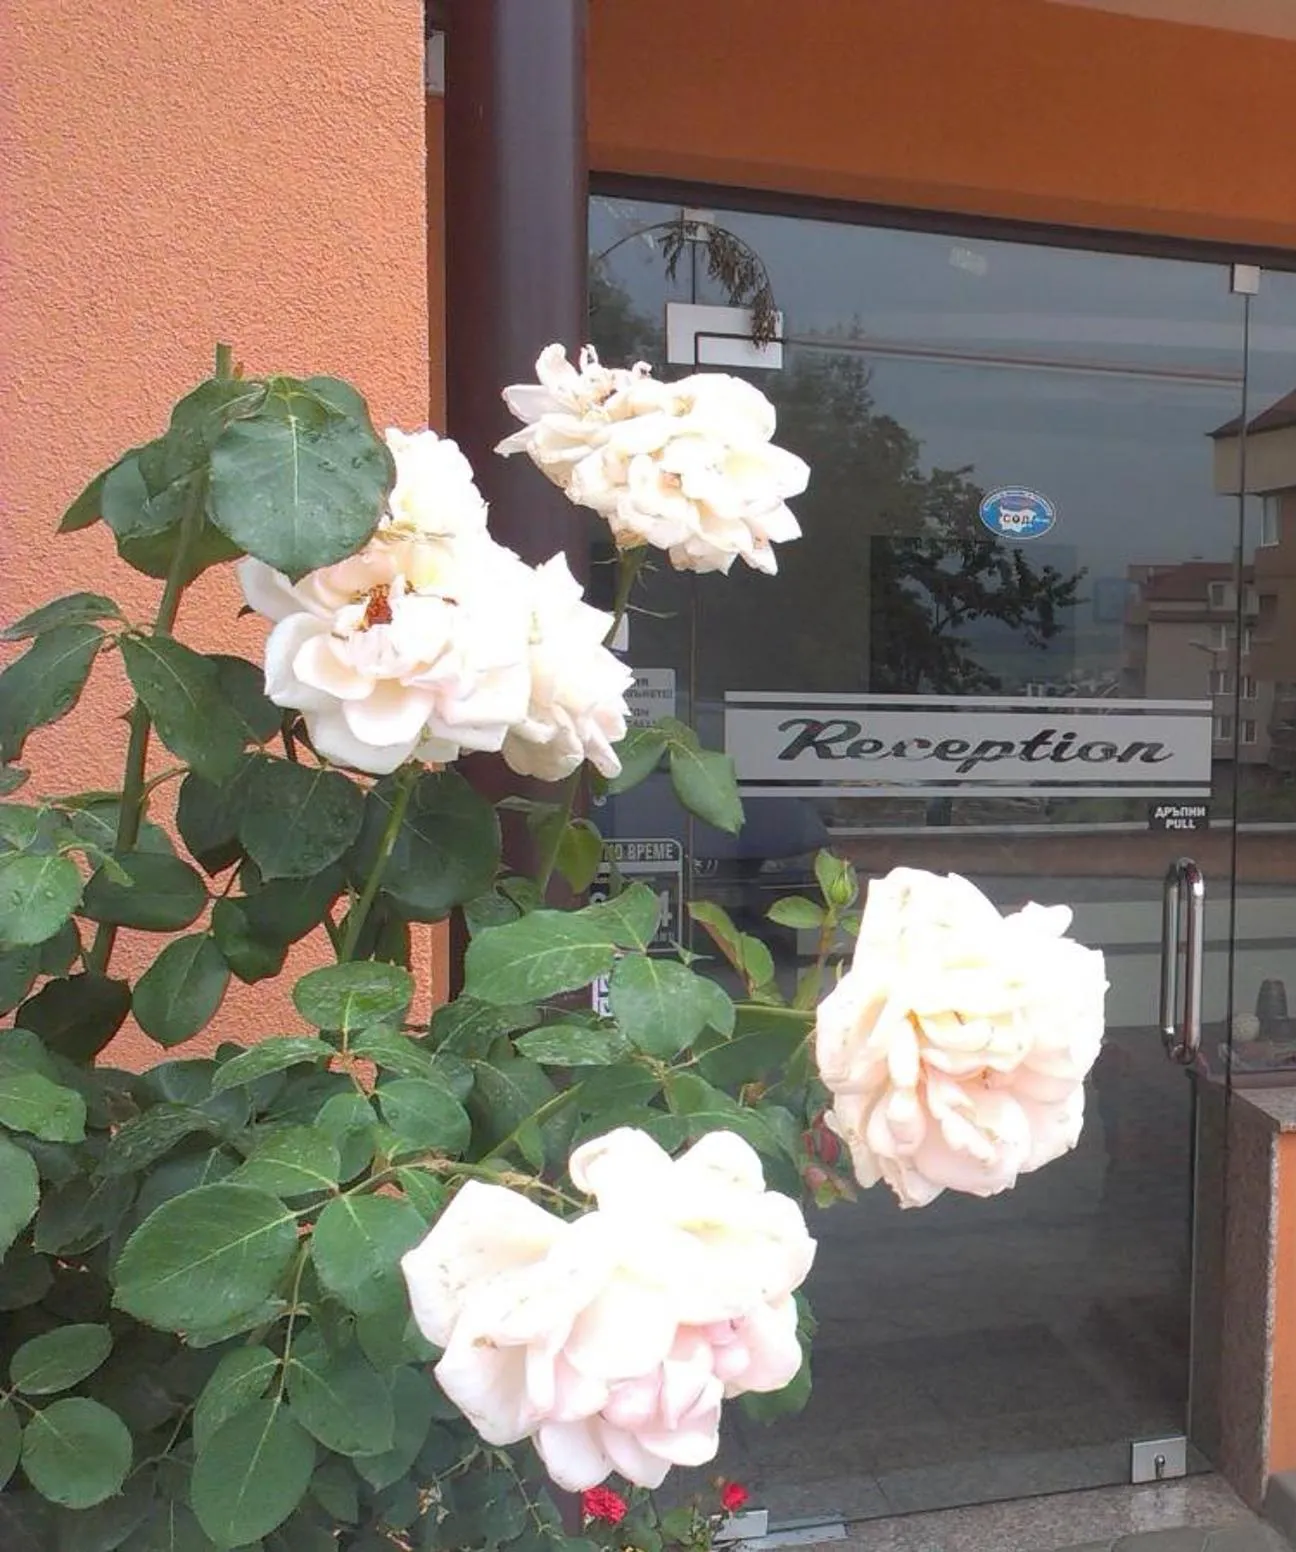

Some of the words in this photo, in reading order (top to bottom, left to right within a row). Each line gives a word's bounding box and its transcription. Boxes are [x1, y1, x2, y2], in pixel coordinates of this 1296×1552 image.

[777, 717, 1174, 774] Reception
[1154, 806, 1206, 819] ДРЪПНИ
[1165, 818, 1197, 829] PULL
[627, 843, 673, 860] ВРЕМЕ
